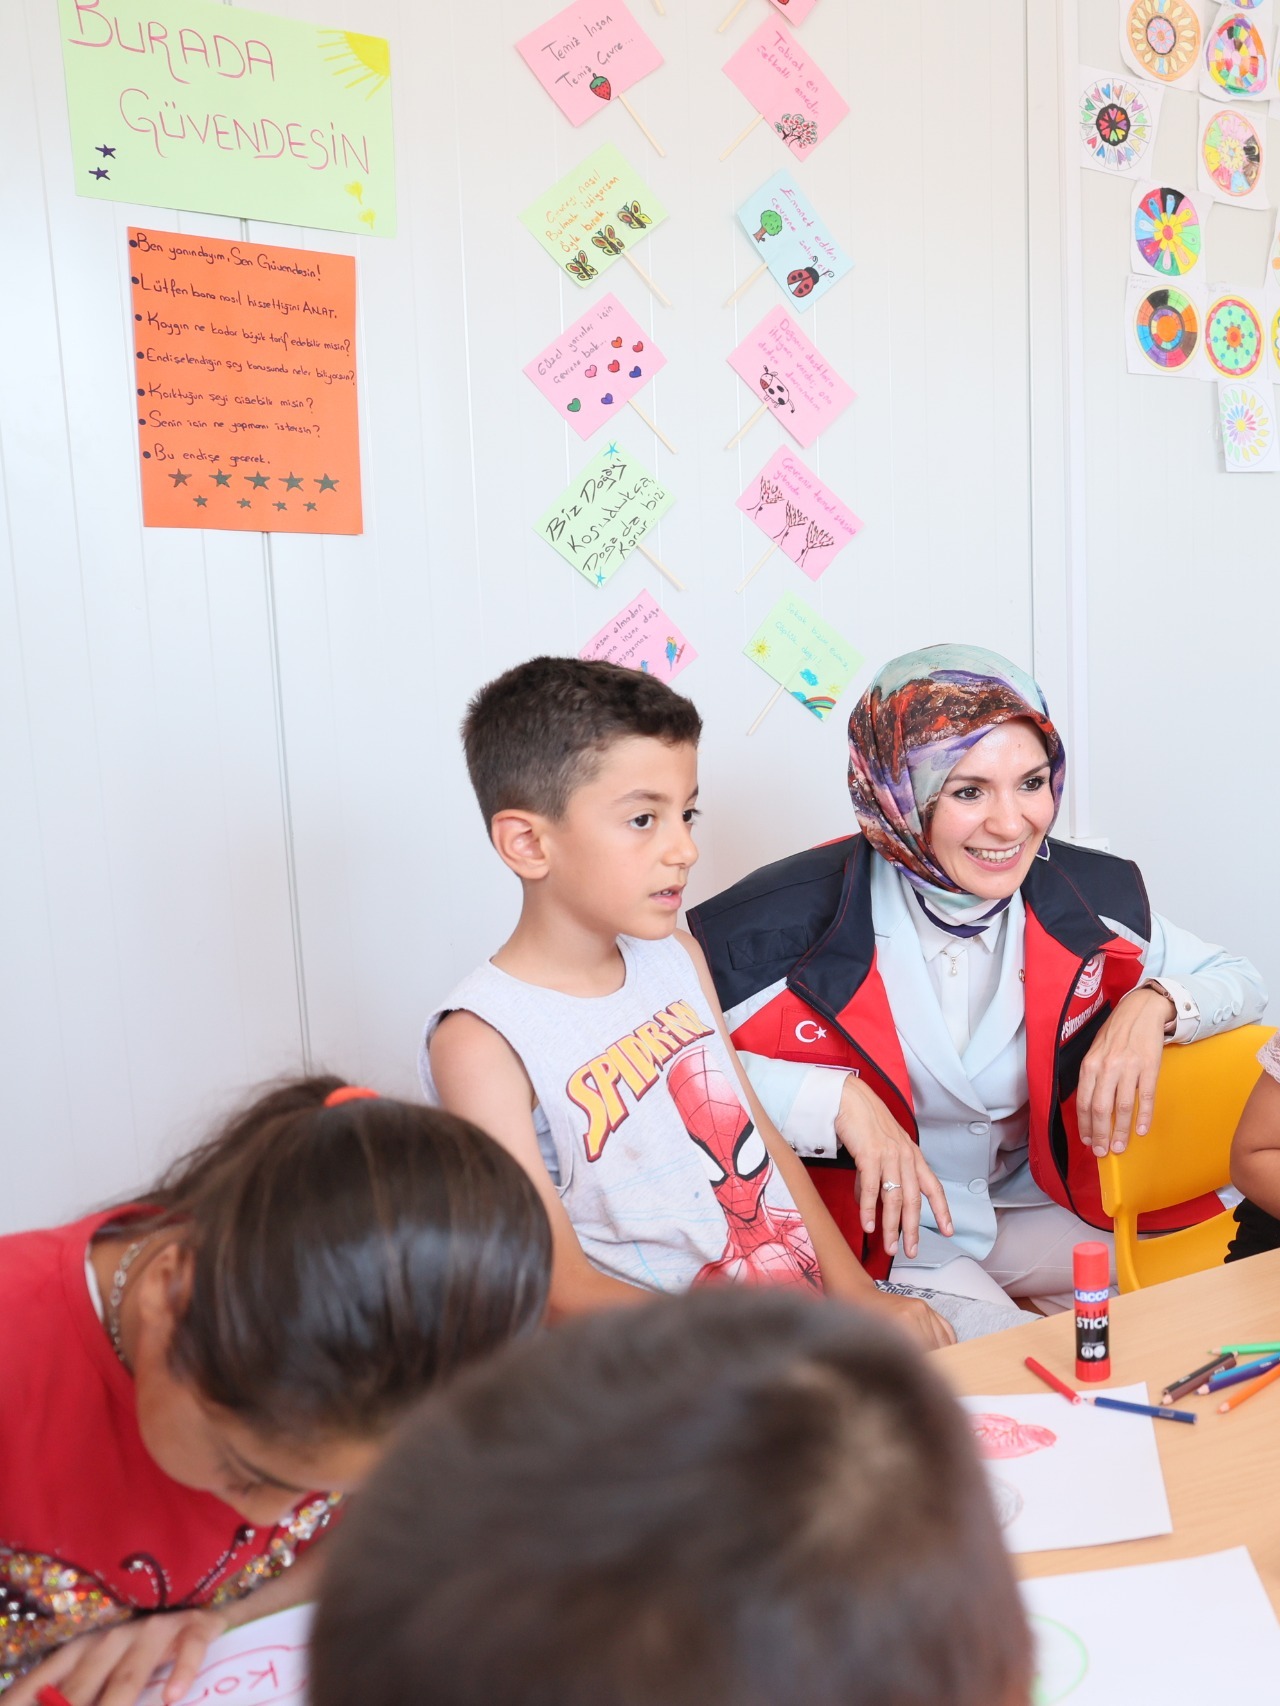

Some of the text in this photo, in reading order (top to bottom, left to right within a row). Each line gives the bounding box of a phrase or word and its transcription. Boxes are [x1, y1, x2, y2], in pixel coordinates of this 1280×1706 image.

[67, 0, 275, 84] BURADA
[119, 88, 370, 175] GÜVENDESİN
[136, 232, 163, 252] Ben
[230, 246, 253, 265] Sen
[140, 273, 188, 298] Lütfen
[219, 290, 242, 305] nasıl
[148, 409, 183, 428] Senin
[154, 442, 175, 461] Bu
[545, 505, 583, 542] Biz
[1076, 1315, 1109, 1330] STICK
